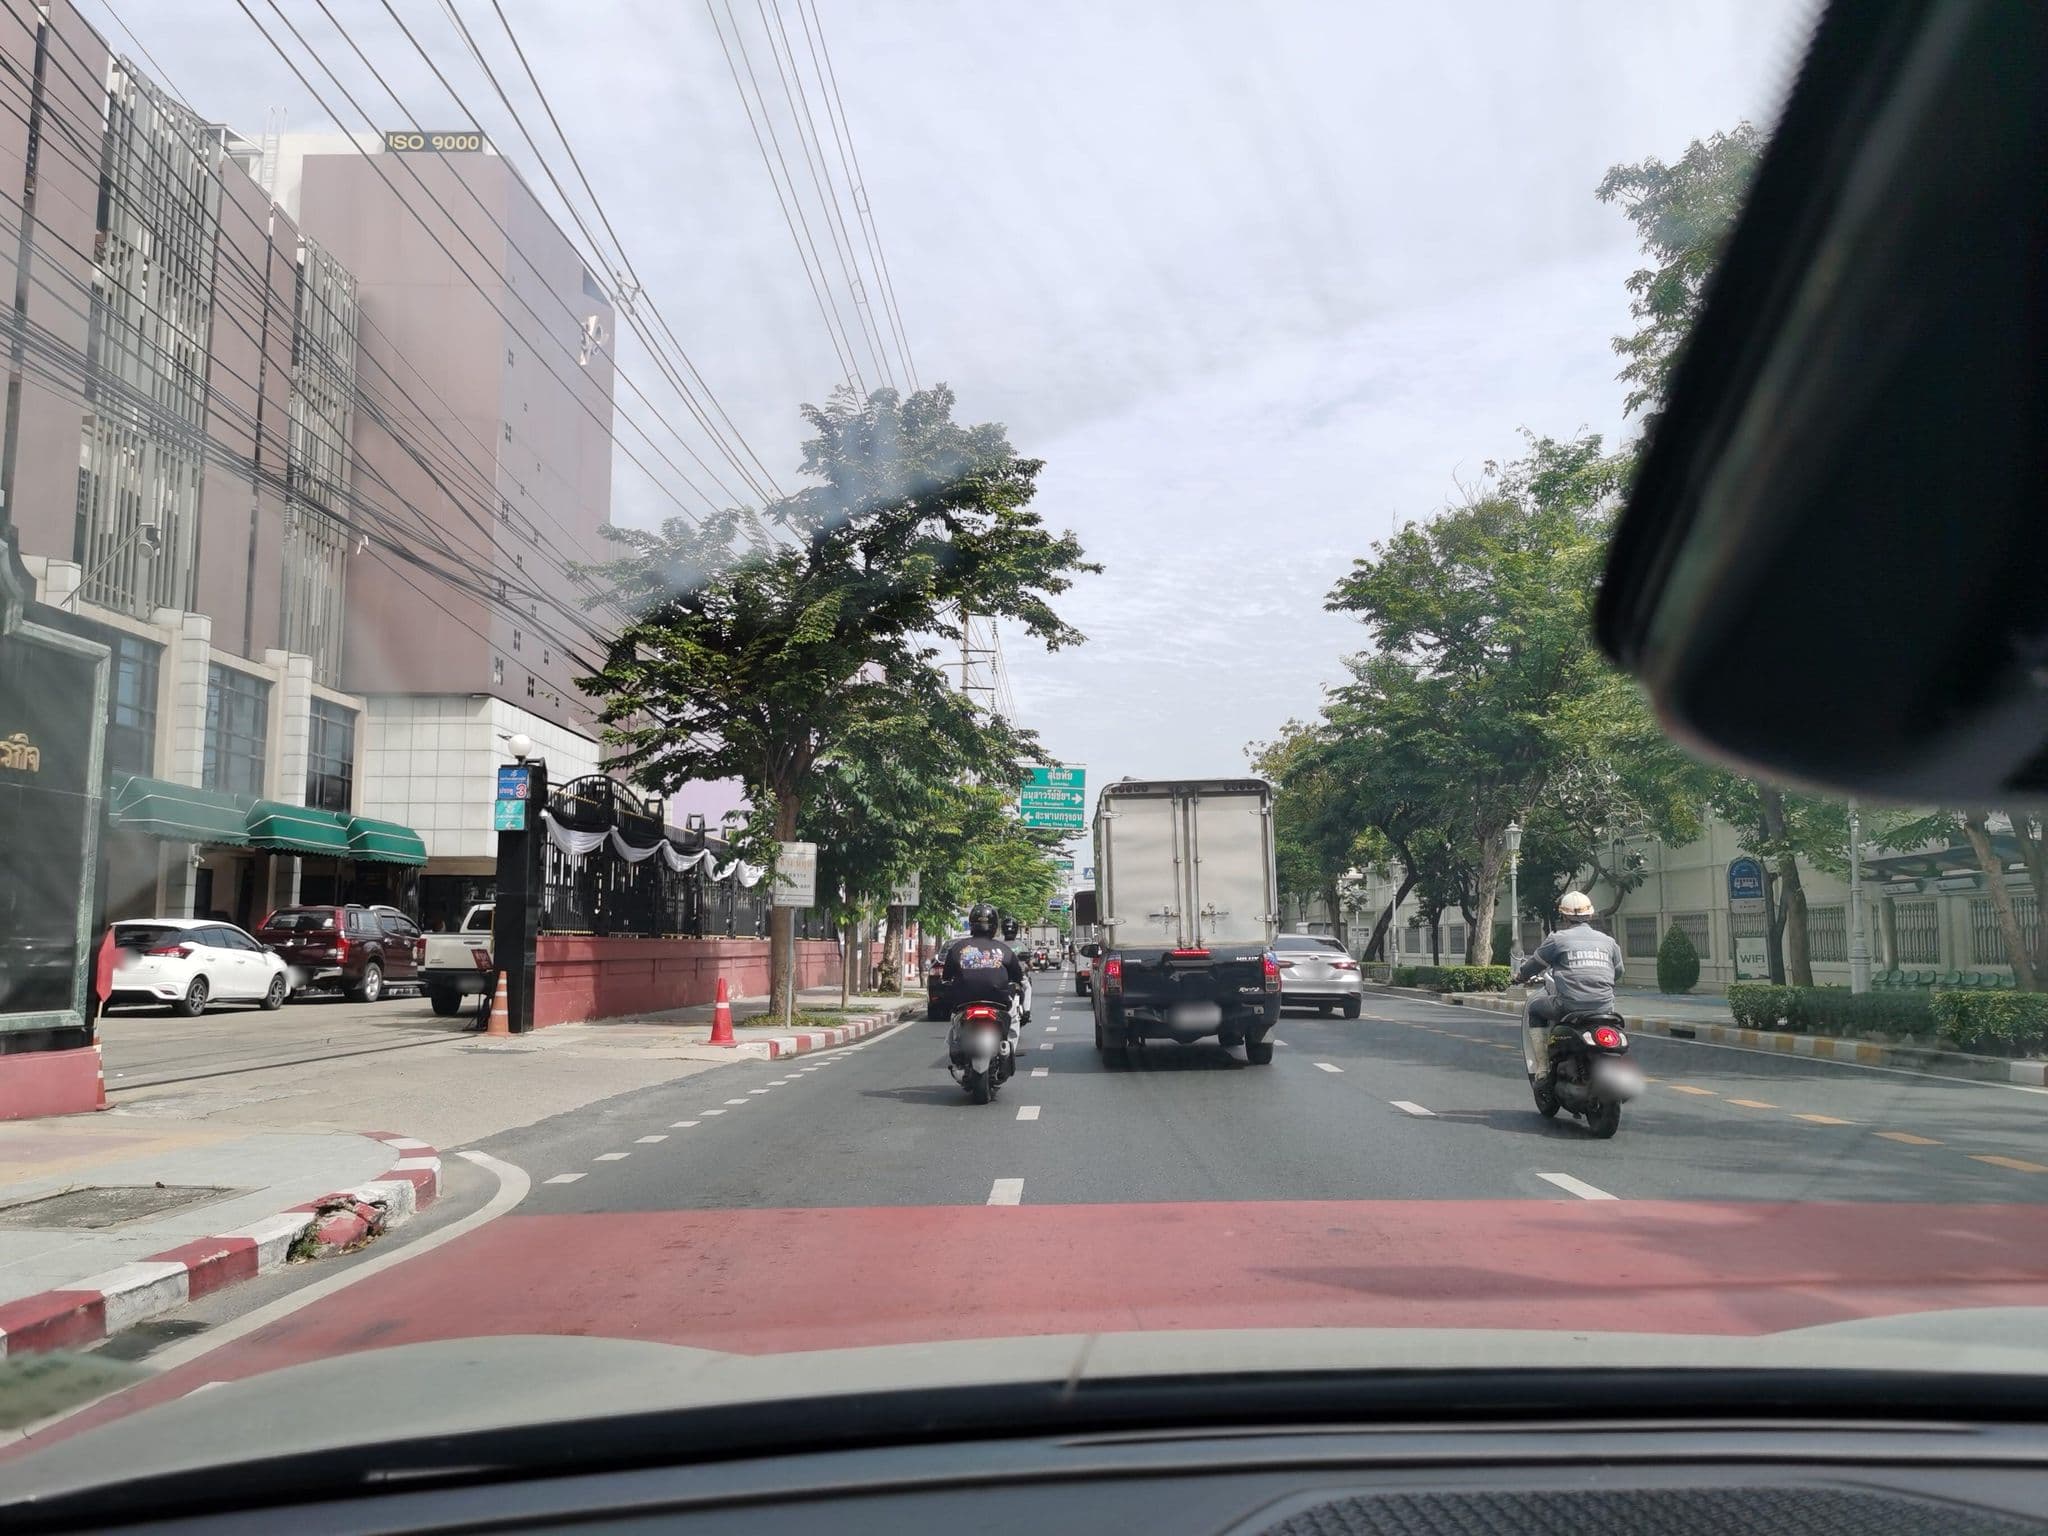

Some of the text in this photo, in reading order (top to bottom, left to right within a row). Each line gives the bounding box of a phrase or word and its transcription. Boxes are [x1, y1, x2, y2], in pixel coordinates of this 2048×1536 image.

[389, 134, 480, 150] ISO 9000
[516, 783, 527, 798] 3
